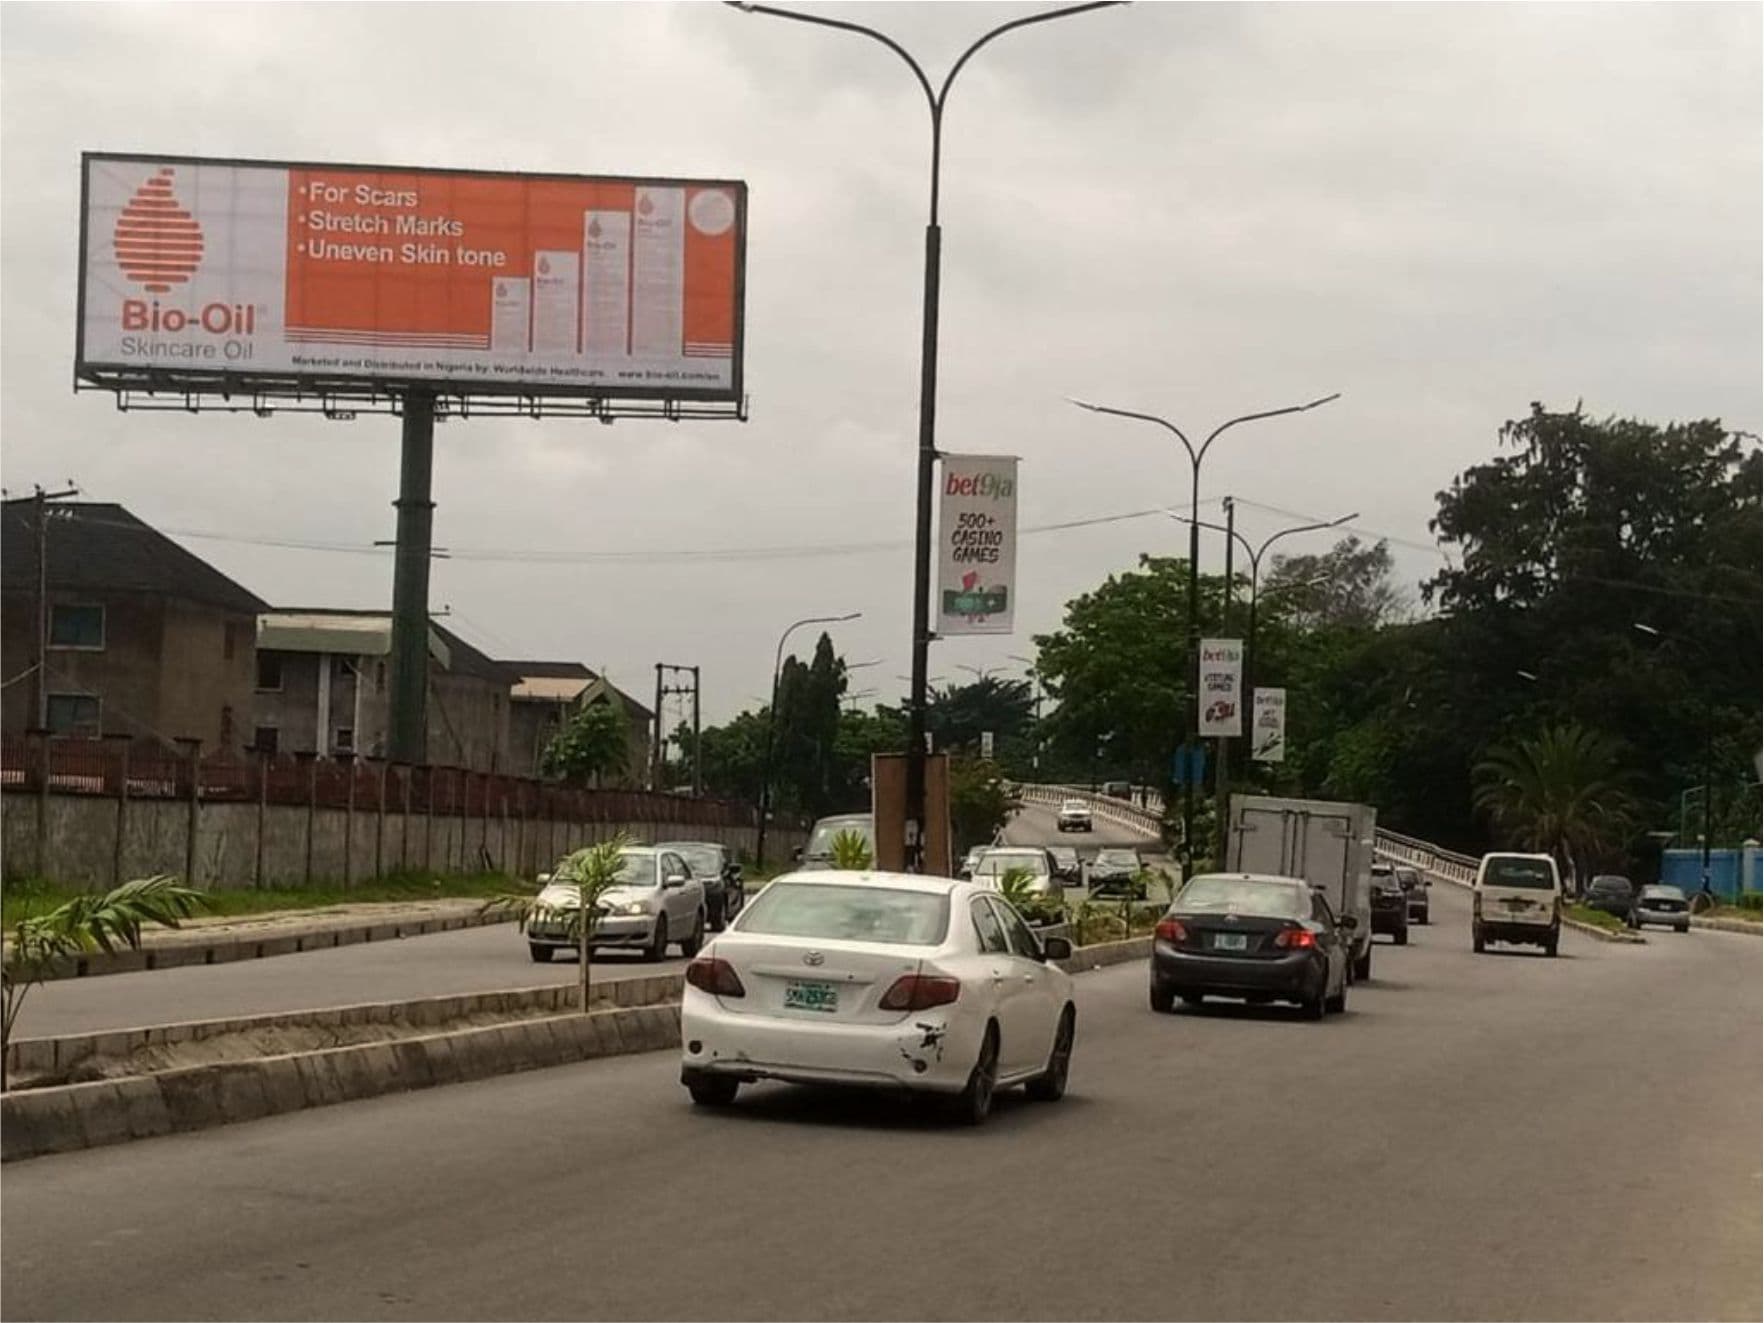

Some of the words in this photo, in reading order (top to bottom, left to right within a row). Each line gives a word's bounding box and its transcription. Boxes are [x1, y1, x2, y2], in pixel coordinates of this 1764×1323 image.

[309, 182, 349, 203] For
[355, 184, 418, 207] Scars
[308, 210, 389, 234] Stretch
[395, 215, 464, 237] Marks
[308, 239, 394, 263] Uneven
[400, 242, 450, 264] Skin
[457, 247, 506, 267] tone
[121, 299, 256, 335] Bio-Oil
[120, 336, 217, 360] Skincare
[223, 339, 254, 360] Oil
[945, 472, 1012, 500] bet9ja
[957, 513, 996, 529] 500+
[951, 530, 1002, 546] CASINO
[952, 547, 1000, 563] GAMES
